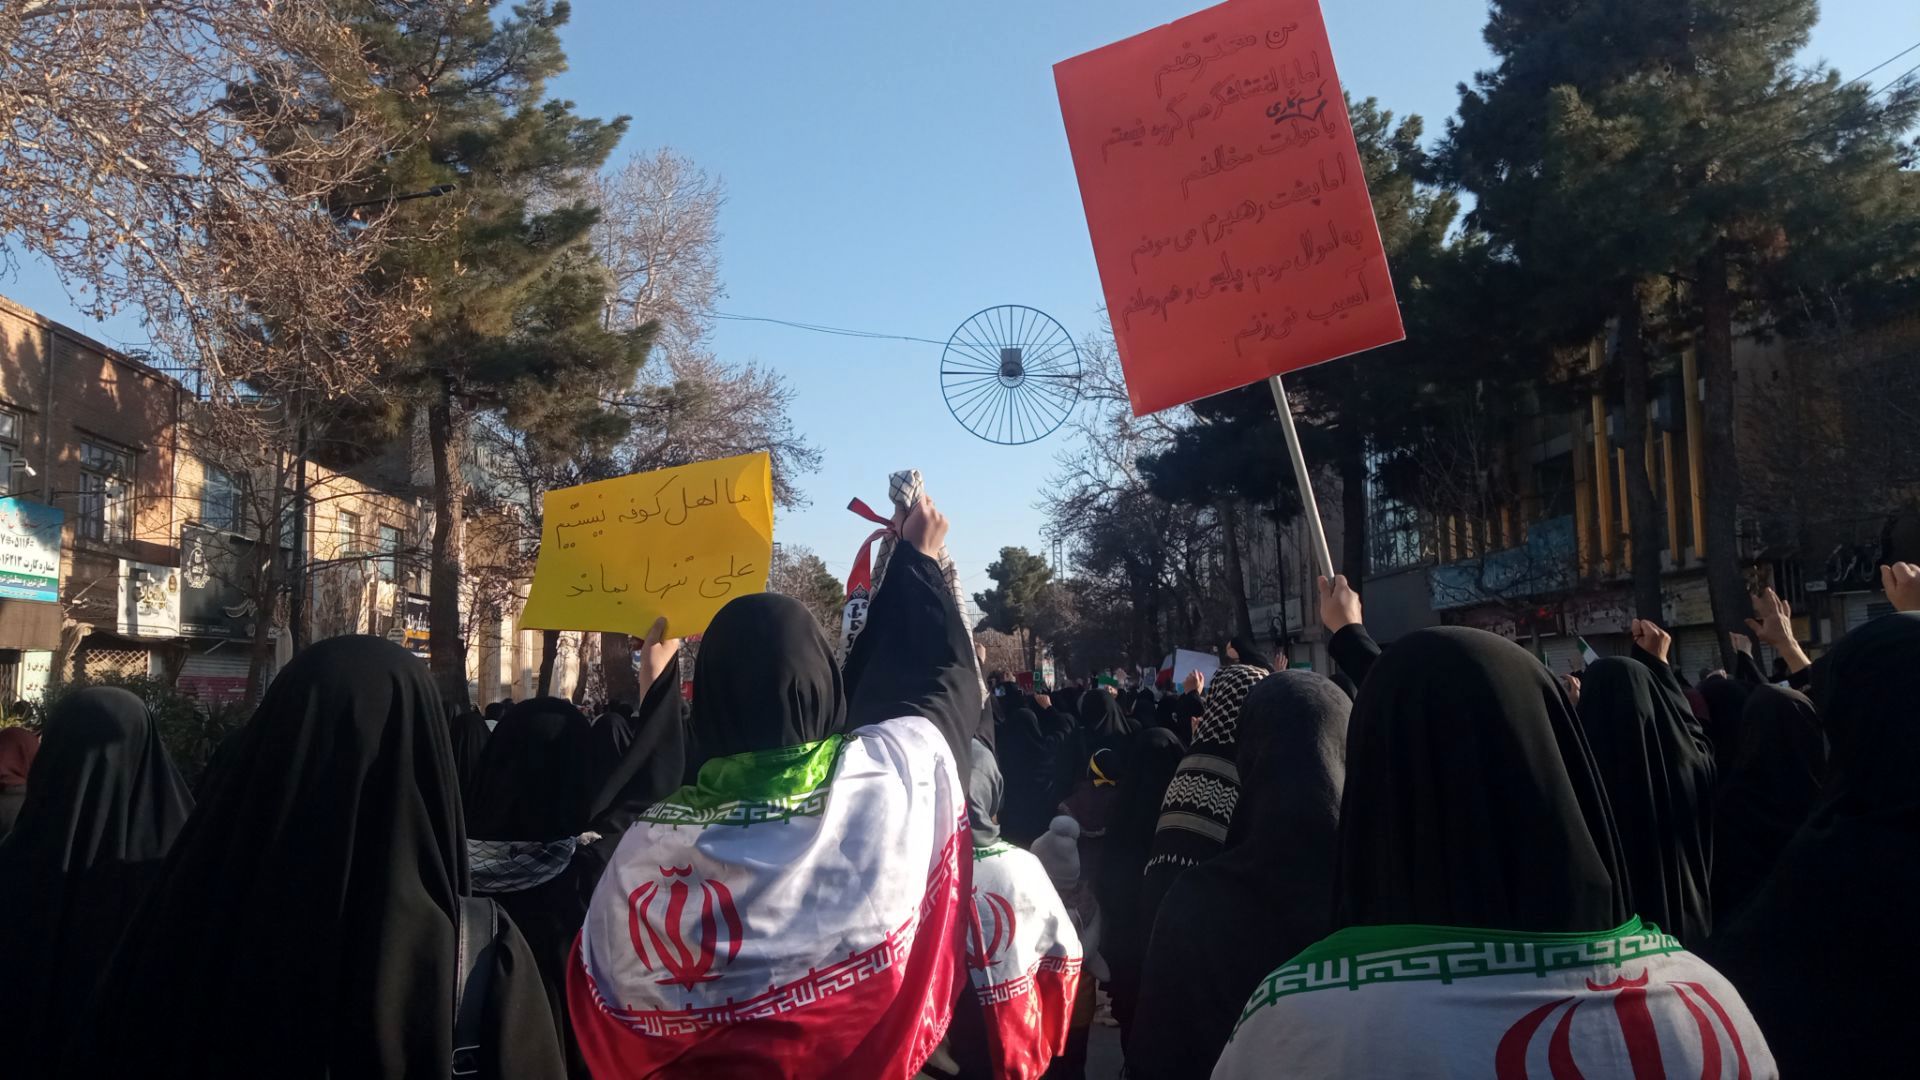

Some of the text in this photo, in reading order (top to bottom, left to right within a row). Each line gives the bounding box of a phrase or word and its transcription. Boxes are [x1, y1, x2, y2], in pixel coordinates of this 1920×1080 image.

[1154, 22, 1299, 99] من معترضم
[1294, 50, 1321, 84] اما
[1181, 109, 1336, 201] با دولت مخالفم
[1318, 152, 1347, 192] اما
[1268, 179, 1322, 209] پشت
[1202, 199, 1266, 246] رهبرم
[1295, 219, 1340, 271] اموال
[1342, 229, 1363, 251] به
[1307, 257, 1370, 327] آسیب
[555, 473, 752, 550] ما اهل کوفه نیستیم
[566, 554, 756, 606] علی تنها بماند
